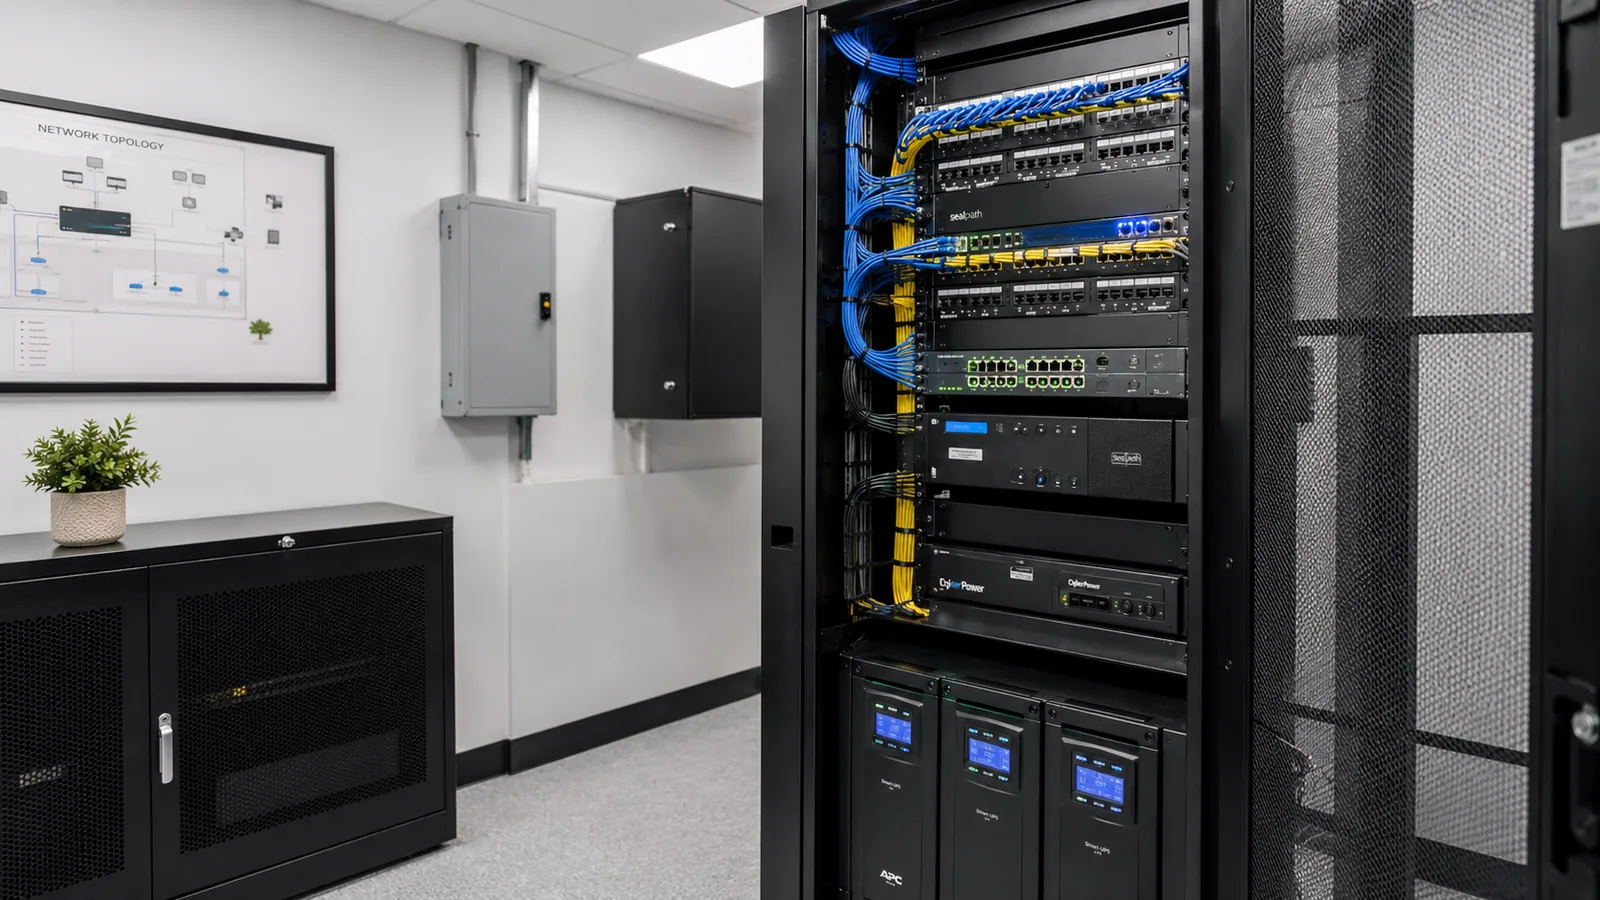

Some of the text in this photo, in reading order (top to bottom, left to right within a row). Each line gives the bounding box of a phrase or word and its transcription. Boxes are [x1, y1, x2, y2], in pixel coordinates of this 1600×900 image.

[38, 123, 164, 151] NETWORK TOPOLOGY
[880, 869, 903, 886] APC
